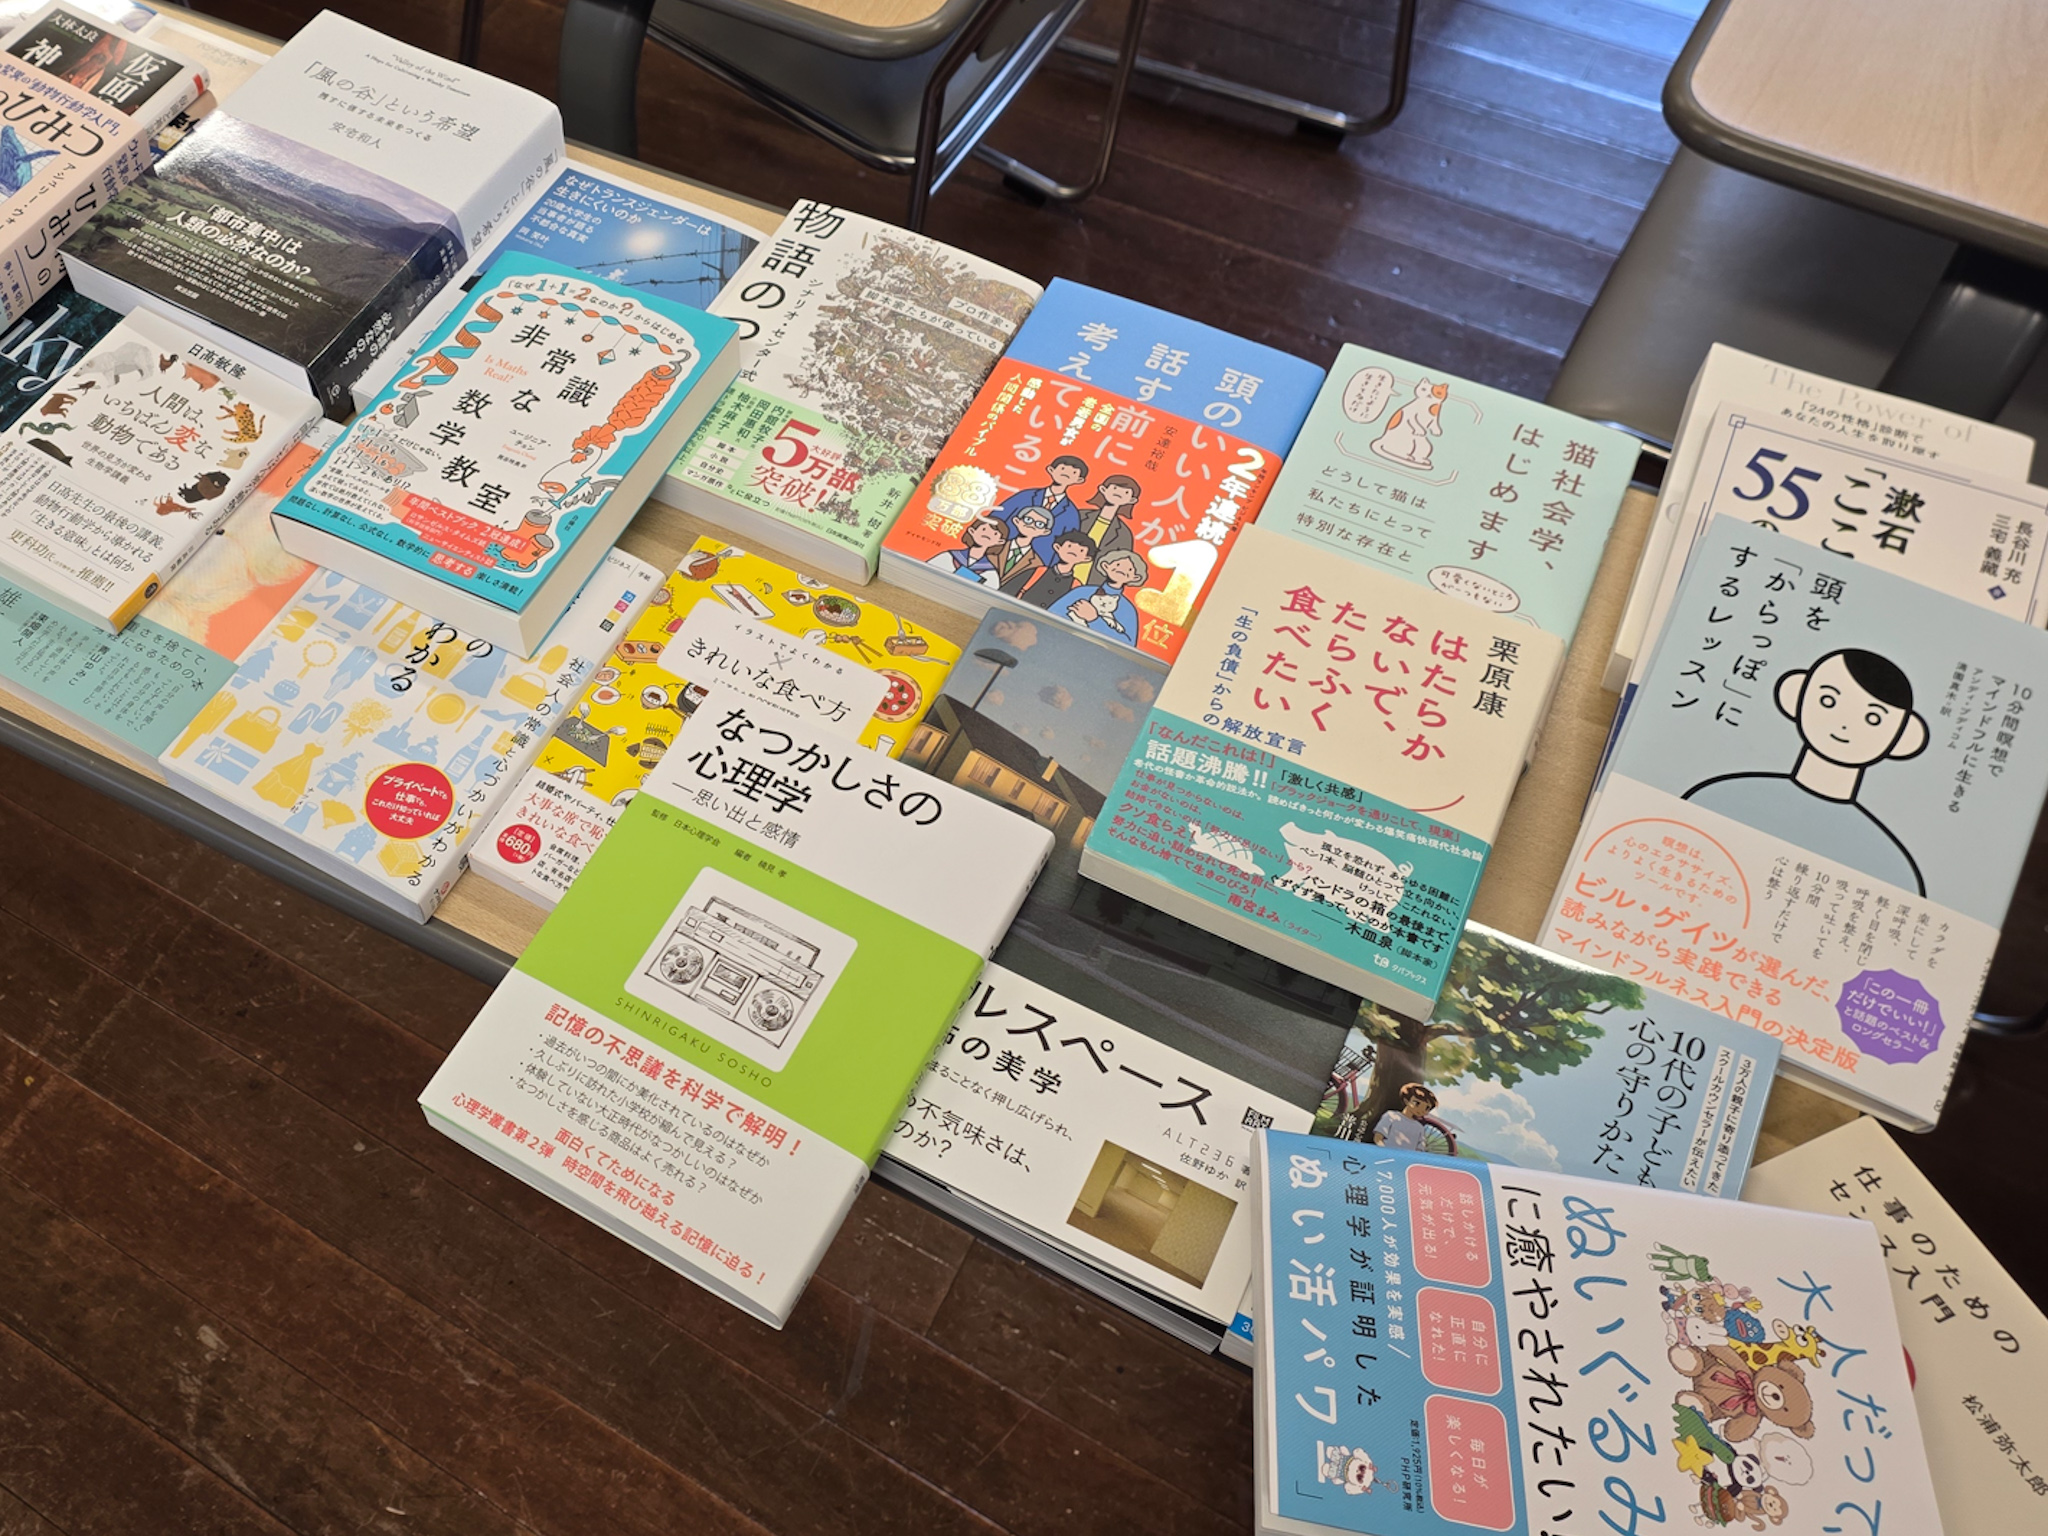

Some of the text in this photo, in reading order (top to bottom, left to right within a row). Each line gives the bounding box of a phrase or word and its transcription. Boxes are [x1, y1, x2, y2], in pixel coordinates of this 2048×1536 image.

[304, 60, 480, 142] 「風の谷」という希望
[329, 121, 381, 149] 安宅和人
[207, 203, 303, 255] 「都市集中」は
[553, 185, 643, 225] 生きにくいのか
[565, 174, 712, 237] なぜトランスジェンダーは
[166, 210, 311, 279] 人類の必然なのか?
[739, 277, 824, 383] シナリオ・センター式
[864, 289, 999, 351] 脚本家たちが使っている
[484, 367, 515, 384] Real?
[497, 358, 529, 377] Maths
[1012, 377, 1044, 415] 感動した
[103, 393, 214, 459] いちばん変な
[139, 384, 207, 430] 人間は、
[963, 372, 1023, 458] 人間関係のバイブル
[975, 321, 1119, 526] 考えていること
[1090, 402, 1116, 433] 全国の
[1094, 342, 1190, 467] 話す前に
[1761, 363, 1978, 445] The Power of
[1781, 407, 1941, 461] あなたの人生を取り戻す
[87, 412, 180, 471] 動物である
[700, 461, 725, 476] 自分史
[762, 418, 862, 493] 5万部
[1135, 367, 1265, 547] 頭のいい人が
[744, 464, 829, 513] 突破!
[867, 486, 902, 529] 新井一樹
[1194, 447, 1266, 547] 2年連続
[1308, 488, 1432, 539] 私たちにとって
[1321, 465, 1429, 511] どうして猫は
[1468, 423, 1545, 561] はじめます
[1529, 440, 1599, 571] 猫社会学、
[29, 508, 135, 573] 「生きる意味」とは何か
[33, 493, 154, 563] 動物行動学から導かれる
[921, 513, 964, 539] 突破
[1296, 512, 1413, 563] 特別な存在と
[431, 552, 474, 577] 思考する
[1671, 543, 1759, 710] するレッスン
[1806, 571, 1847, 632] 頭を
[390, 622, 458, 692] わかる
[1253, 585, 1326, 713] 食べたい
[1309, 602, 1368, 732] たらふく
[1364, 615, 1419, 732] ないで、
[1472, 635, 1521, 719] 栗原康
[1715, 556, 1803, 728] 「からっぽ」に
[687, 637, 852, 723] きれいな食べ方
[1401, 629, 1468, 761] はたらか
[688, 745, 813, 814] 心理学
[716, 707, 943, 827] なつかしさの
[1144, 739, 1269, 788] 話題沸騰!!
[1948, 675, 2006, 814] マインドフルに生きる
[1280, 769, 1364, 803] 「激しく共感」
[673, 819, 722, 847] 日本心理学会
[1622, 834, 1736, 891] 心のエクササイズ、
[1606, 844, 1739, 905] よりよく生きるための
[1633, 870, 1705, 909] ツールです。
[1763, 853, 1790, 903] 心は整う
[1771, 861, 1811, 945] 繰り返すだけで
[1804, 870, 1831, 909] 10分間
[1302, 875, 1450, 946] パンドラの箱の最後まで、
[1573, 870, 1833, 1004] ビル・ゲイツが選んだ、
[1810, 878, 1851, 961] 吸って吐いてを
[1838, 886, 1871, 956] 呼吸を整え、
[1855, 894, 1891, 967] 軽く目を閉じ
[1887, 904, 1911, 949] 深呼吸、
[1905, 911, 1930, 962] 楽にして
[1926, 921, 1951, 970] カラダを
[1559, 897, 1783, 1007] 読みながら実践できる
[1553, 926, 1862, 1075] マインドフルネス入門の決定版
[1862, 976, 1931, 1016] 「この一冊
[615, 996, 773, 1089] SHINRIGAKU SOSHO
[1850, 1022, 1916, 1054] ロングセラー
[544, 1002, 803, 1157] 記憶の不思議を科学で解明!
[1592, 1016, 1665, 1176] 心の守りかた
[1635, 1030, 1708, 1188] 10代の子ども
[1162, 1127, 1235, 1168] ALT236
[1681, 1049, 1732, 1188] スクールカウンセラーが伝えたい
[1705, 1057, 1753, 1196] 3万人の親子に寄り添ってきた
[554, 1126, 675, 1208] 面白くてためになる
[1180, 1152, 1229, 1181] 佐野ゆか
[562, 1154, 767, 1287] 時空間を飛び越える記憶に迫る!
[1416, 1182, 1439, 1259] 元気が出る!
[1439, 1196, 1458, 1246] だけで、
[1458, 1191, 1480, 1263] 話しかける
[1342, 1154, 1382, 1407] 心理学が証明した
[1852, 1164, 2021, 1356] 仕事のための
[1428, 1310, 1448, 1361] なれた!
[1449, 1315, 1469, 1362] 正直に
[1469, 1318, 1489, 1367] 自分に
[1562, 1195, 1667, 1536] ぬいぐるみ
[1776, 1269, 1892, 1536] 大人だって
[1444, 1414, 1467, 1504] 楽しくなる!
[1469, 1438, 1490, 1490] 毎日が
[1961, 1392, 2048, 1498] 松浦弥太郎
[1400, 1456, 1413, 1512] PHP研究所
